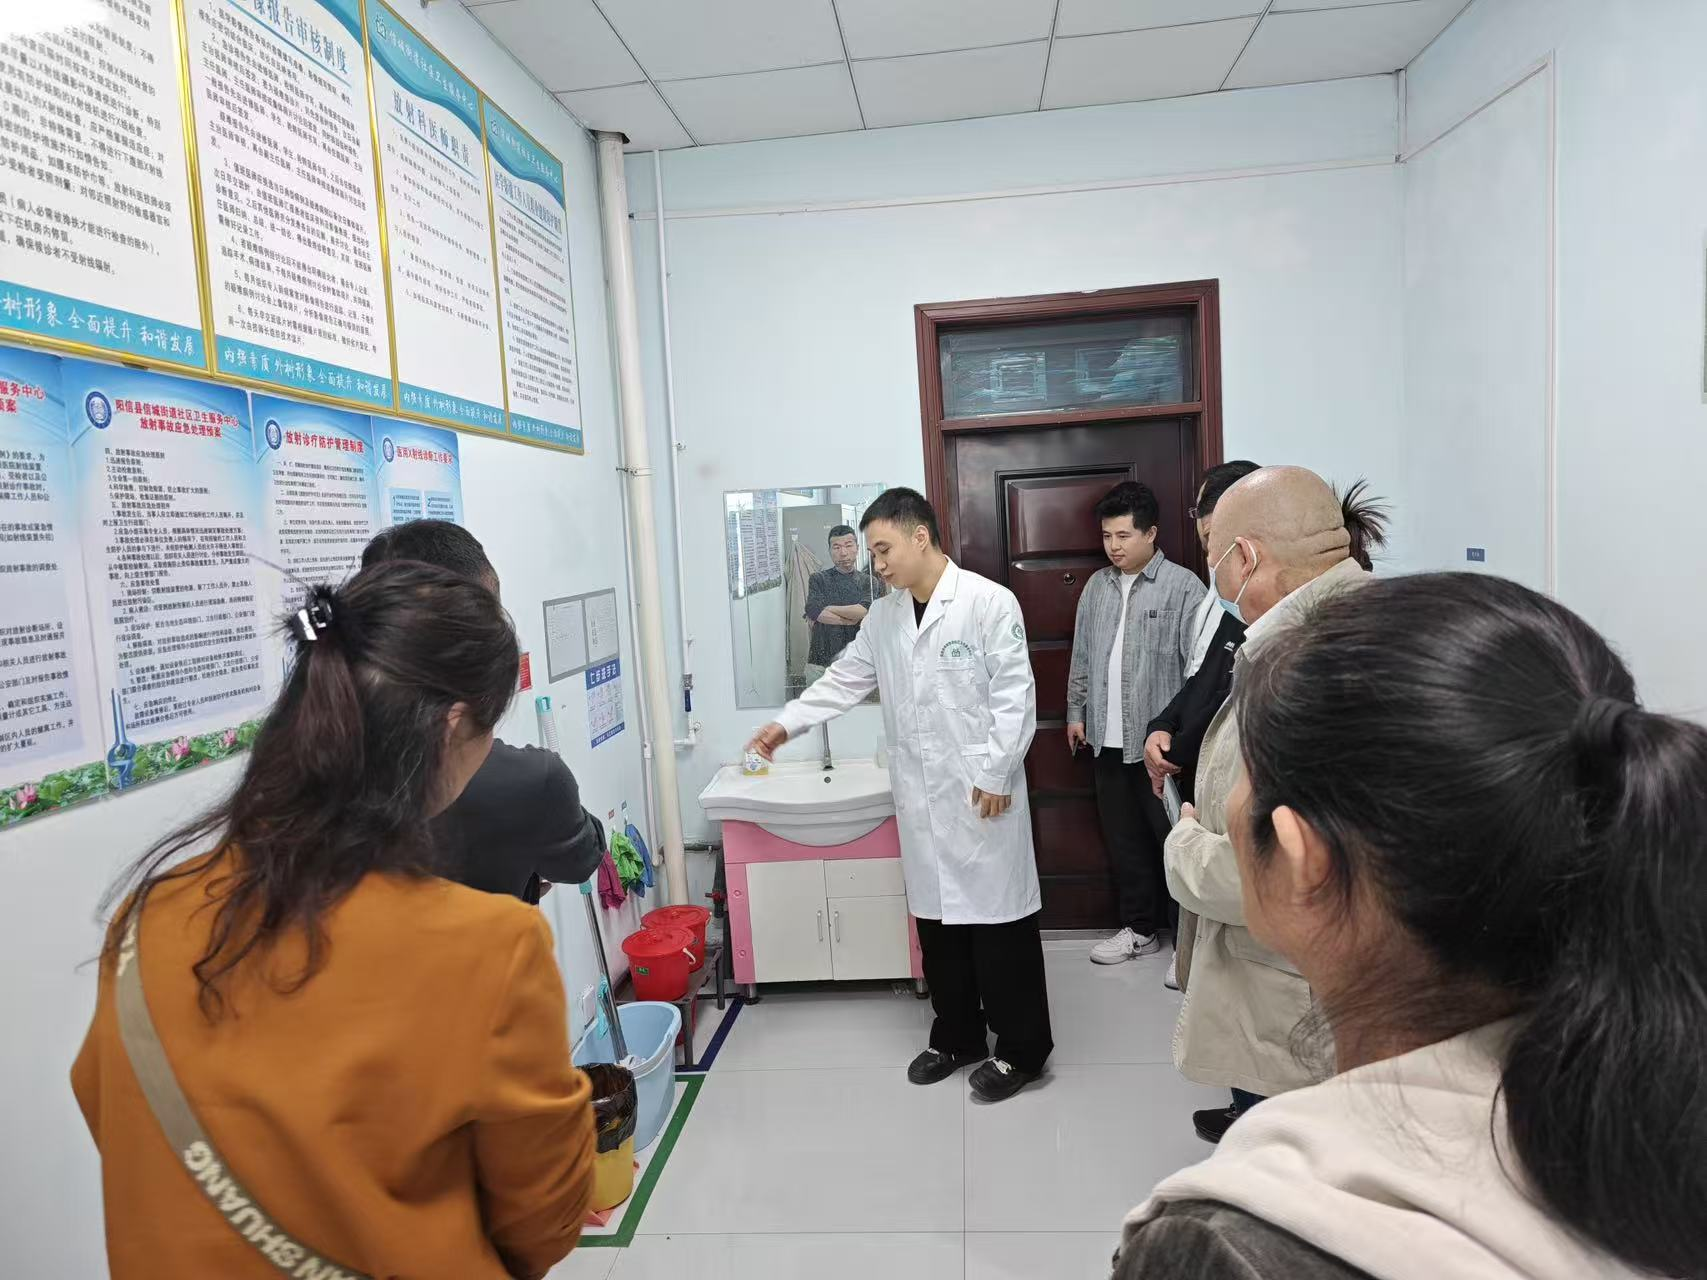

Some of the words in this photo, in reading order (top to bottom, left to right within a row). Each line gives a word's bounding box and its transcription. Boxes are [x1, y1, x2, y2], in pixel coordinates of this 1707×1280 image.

[393, 90, 470, 166] 放射科医师职责
[0, 291, 63, 328] 树形象
[67, 306, 132, 342] 全面提升
[139, 326, 194, 357] 和谐发展
[115, 398, 240, 427] 阳信县信城街道社区卫生服务中心
[140, 416, 222, 438] 放射事故应急处理预案
[285, 430, 364, 453] 放射诊疗防护管理制度
[184, 1141, 304, 1268] SHUANG
